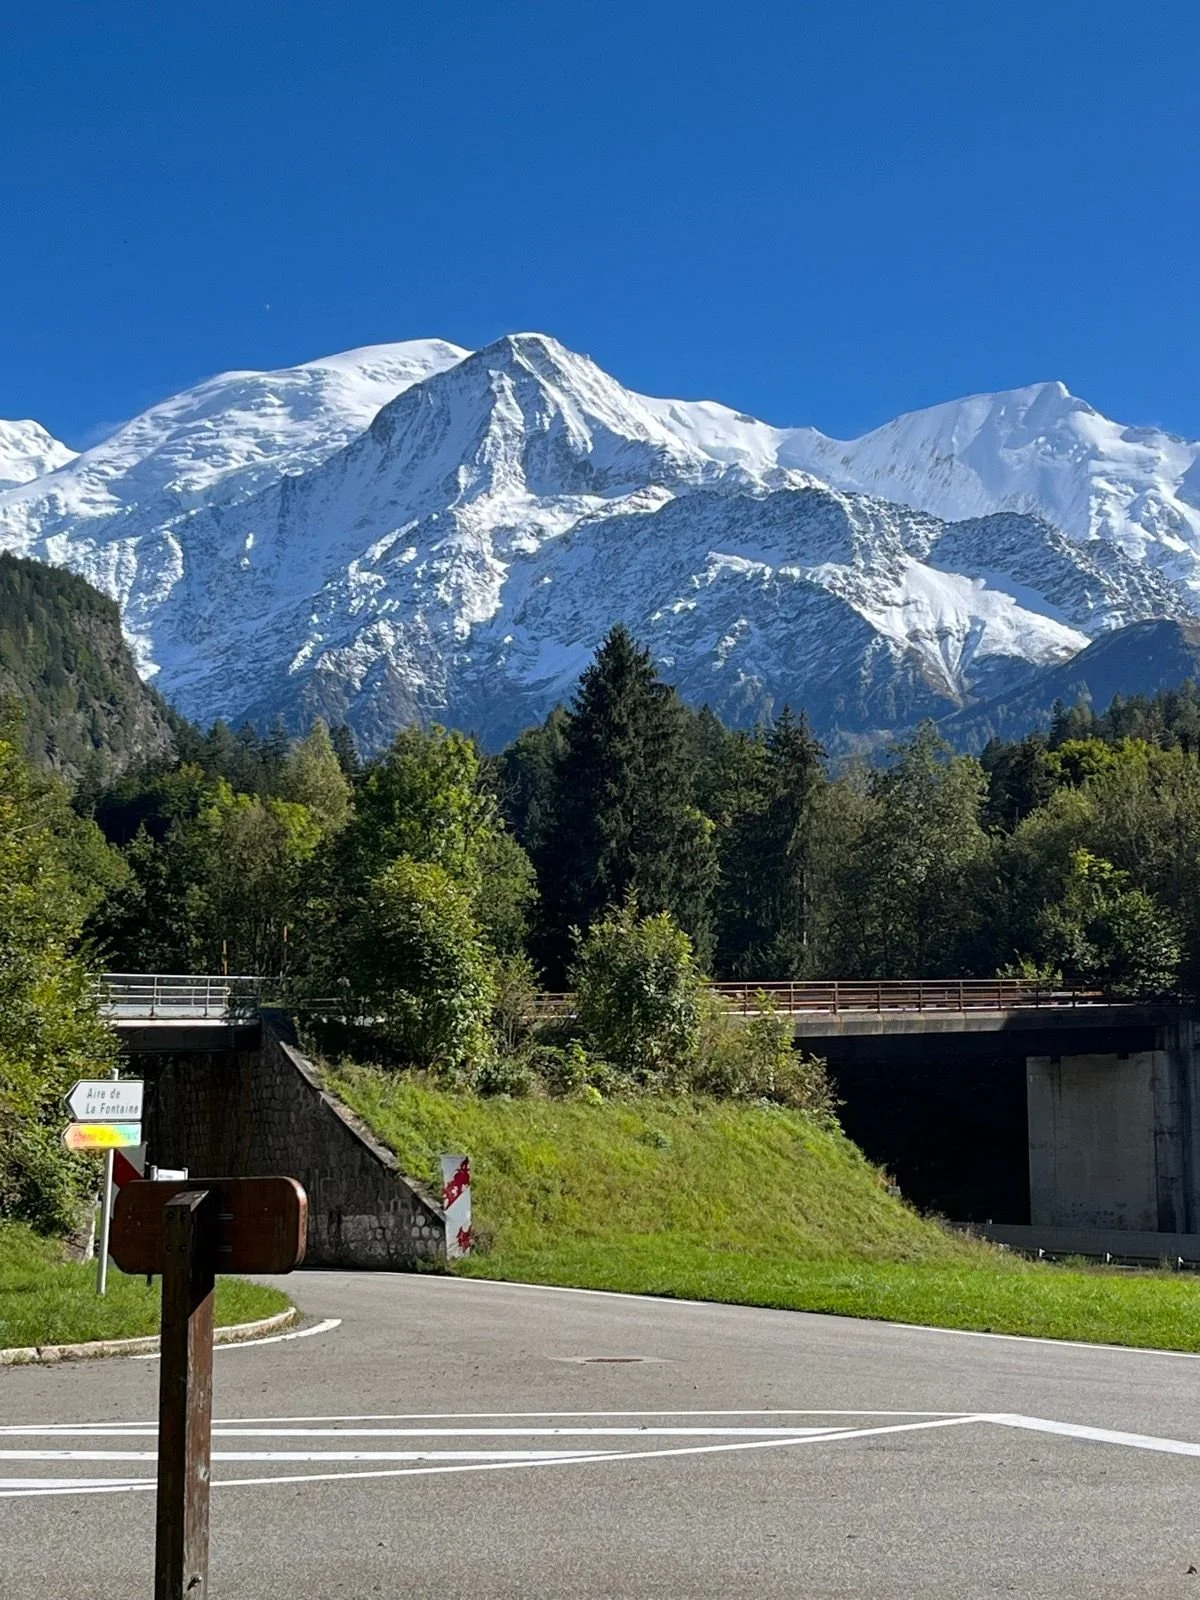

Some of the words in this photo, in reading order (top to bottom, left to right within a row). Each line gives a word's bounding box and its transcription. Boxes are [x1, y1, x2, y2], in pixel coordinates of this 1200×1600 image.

[87, 1088, 106, 1099] Aire
[110, 1088, 121, 1099] de
[85, 1103, 96, 1114] La
[100, 1103, 139, 1114] Fontaine
